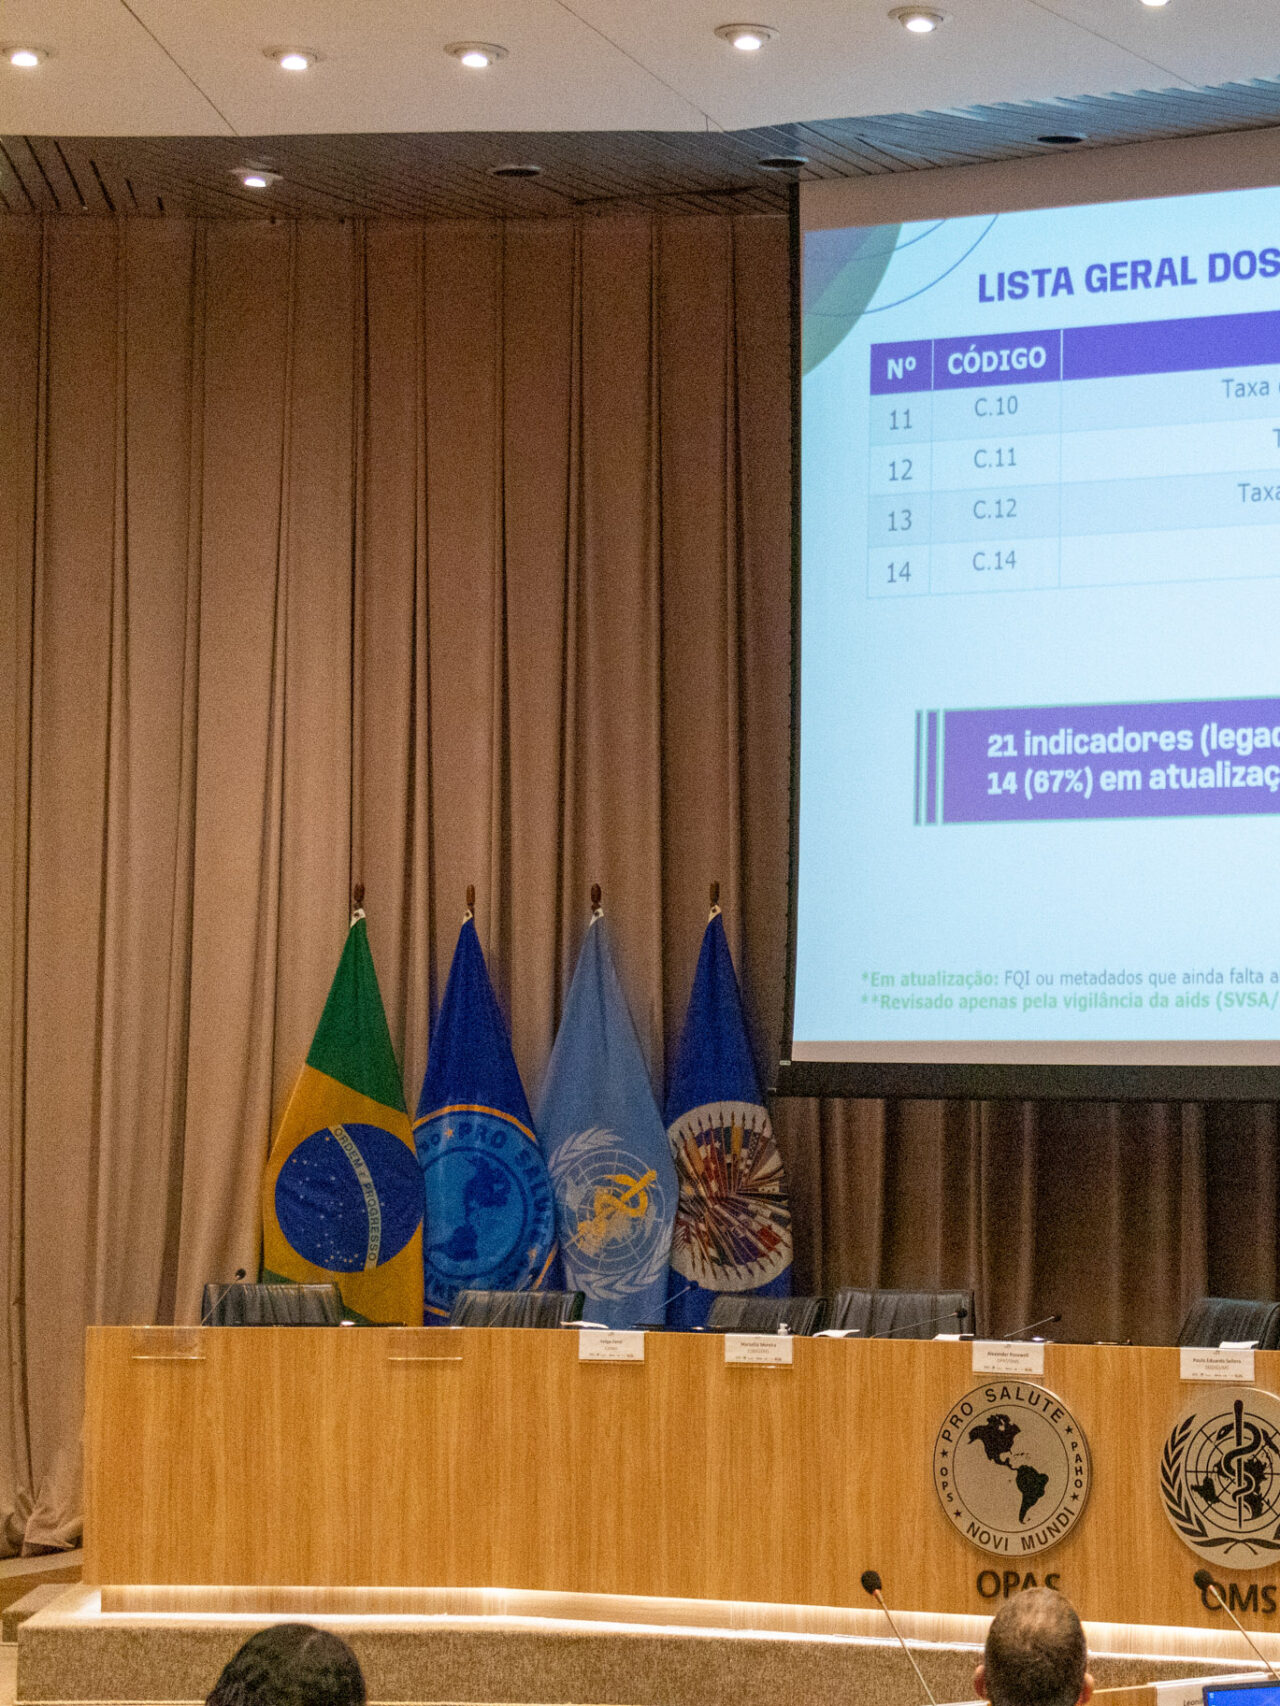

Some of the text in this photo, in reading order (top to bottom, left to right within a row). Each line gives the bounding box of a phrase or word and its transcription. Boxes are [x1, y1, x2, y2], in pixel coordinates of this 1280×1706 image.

[978, 265, 1074, 303] LISTA
[1084, 256, 1198, 293] GERAL
[887, 355, 917, 380] Nº
[947, 344, 1047, 376] CÓDIGO
[1221, 377, 1271, 400] Taxa
[973, 395, 1019, 418] C.10
[888, 409, 913, 431] 11
[973, 447, 1018, 470] C.11
[887, 460, 914, 482] 12
[886, 510, 913, 532] 13
[972, 498, 1018, 521] C.12
[885, 561, 912, 585] 14
[971, 549, 1017, 573] C.14
[986, 733, 1018, 758] 21
[1023, 724, 1194, 756] indicadores
[986, 770, 1018, 795] 14
[1024, 765, 1094, 801] (67%)
[1100, 770, 1142, 792] em
[901, 970, 999, 991] atualização:
[1004, 970, 1030, 989] FQI
[1036, 973, 1054, 986] ou
[1059, 969, 1143, 986] metadados
[1149, 970, 1176, 989] que
[1182, 967, 1224, 985] ainda
[1230, 967, 1265, 985] falta
[958, 995, 1018, 1011] apenas
[1022, 993, 1057, 1012] pela
[1063, 992, 1143, 1013] vigilância
[1150, 992, 1169, 1008] da
[1175, 991, 1210, 1008] aids
[334, 1127, 364, 1168] ORDEM
[363, 1182, 380, 1262] PROGRESSO
[941, 1386, 1065, 1443] PRO SALUTE
[1070, 1441, 1083, 1489] PAHO
[940, 1467, 954, 1503] OPS
[966, 1506, 1076, 1551] NOVI MUNDI
[1201, 1581, 1277, 1614] OMS
